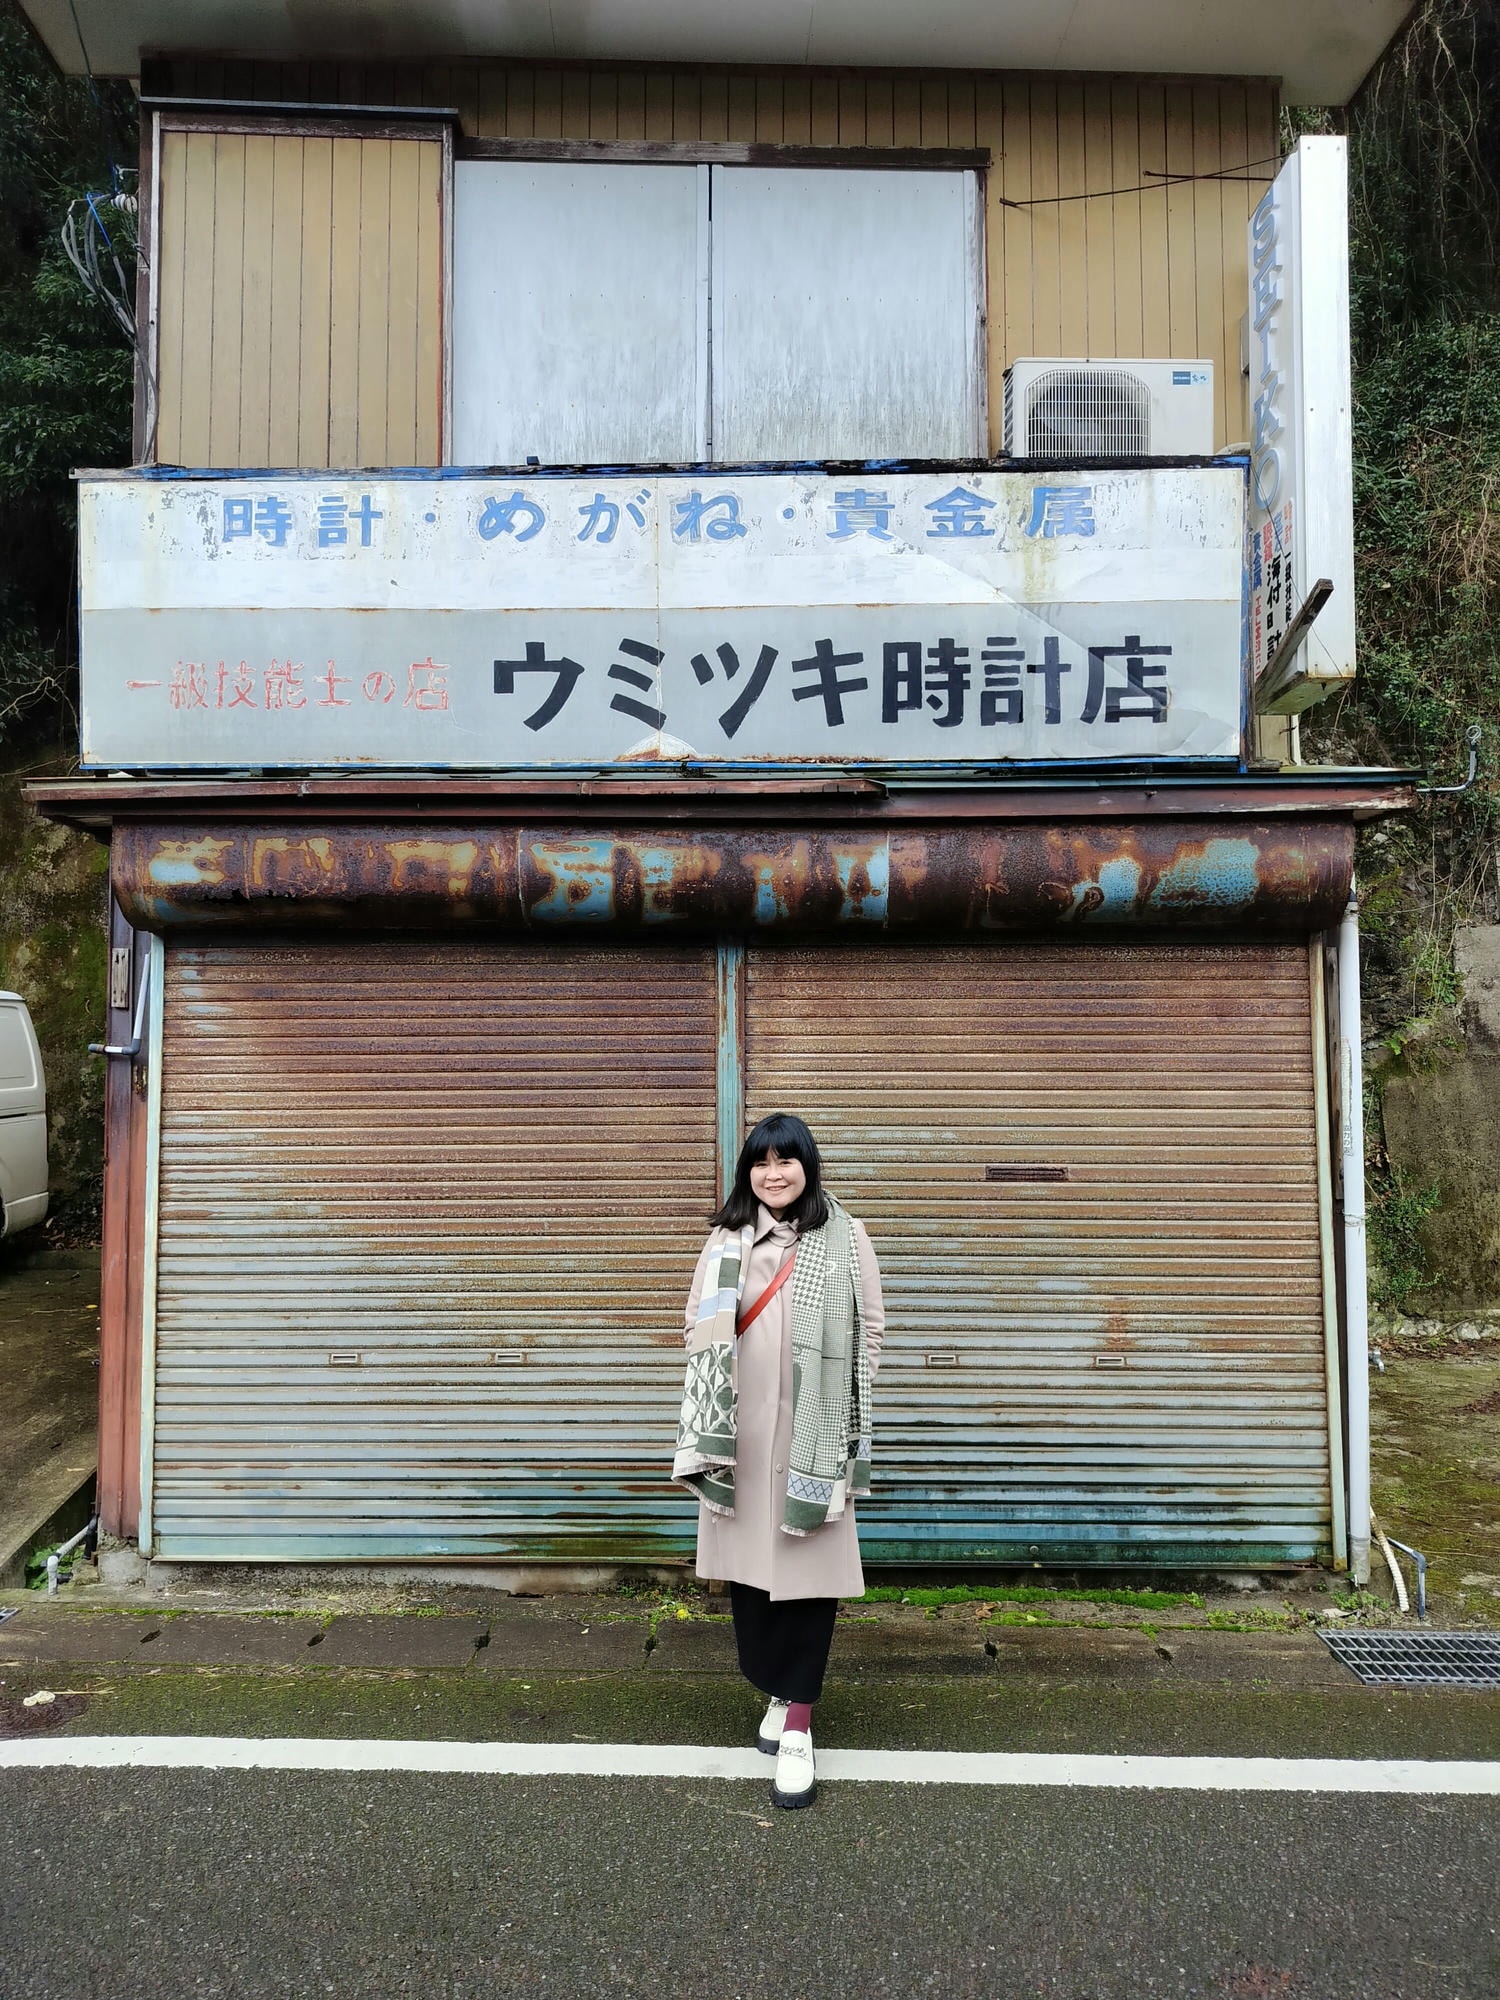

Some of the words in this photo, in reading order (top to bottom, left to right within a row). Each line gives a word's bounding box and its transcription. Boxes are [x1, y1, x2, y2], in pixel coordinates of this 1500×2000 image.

[1253, 184, 1280, 511] SEIKO
[125, 656, 450, 711] 一級技能士の店
[493, 635, 1172, 738] ウミツキ時計店
